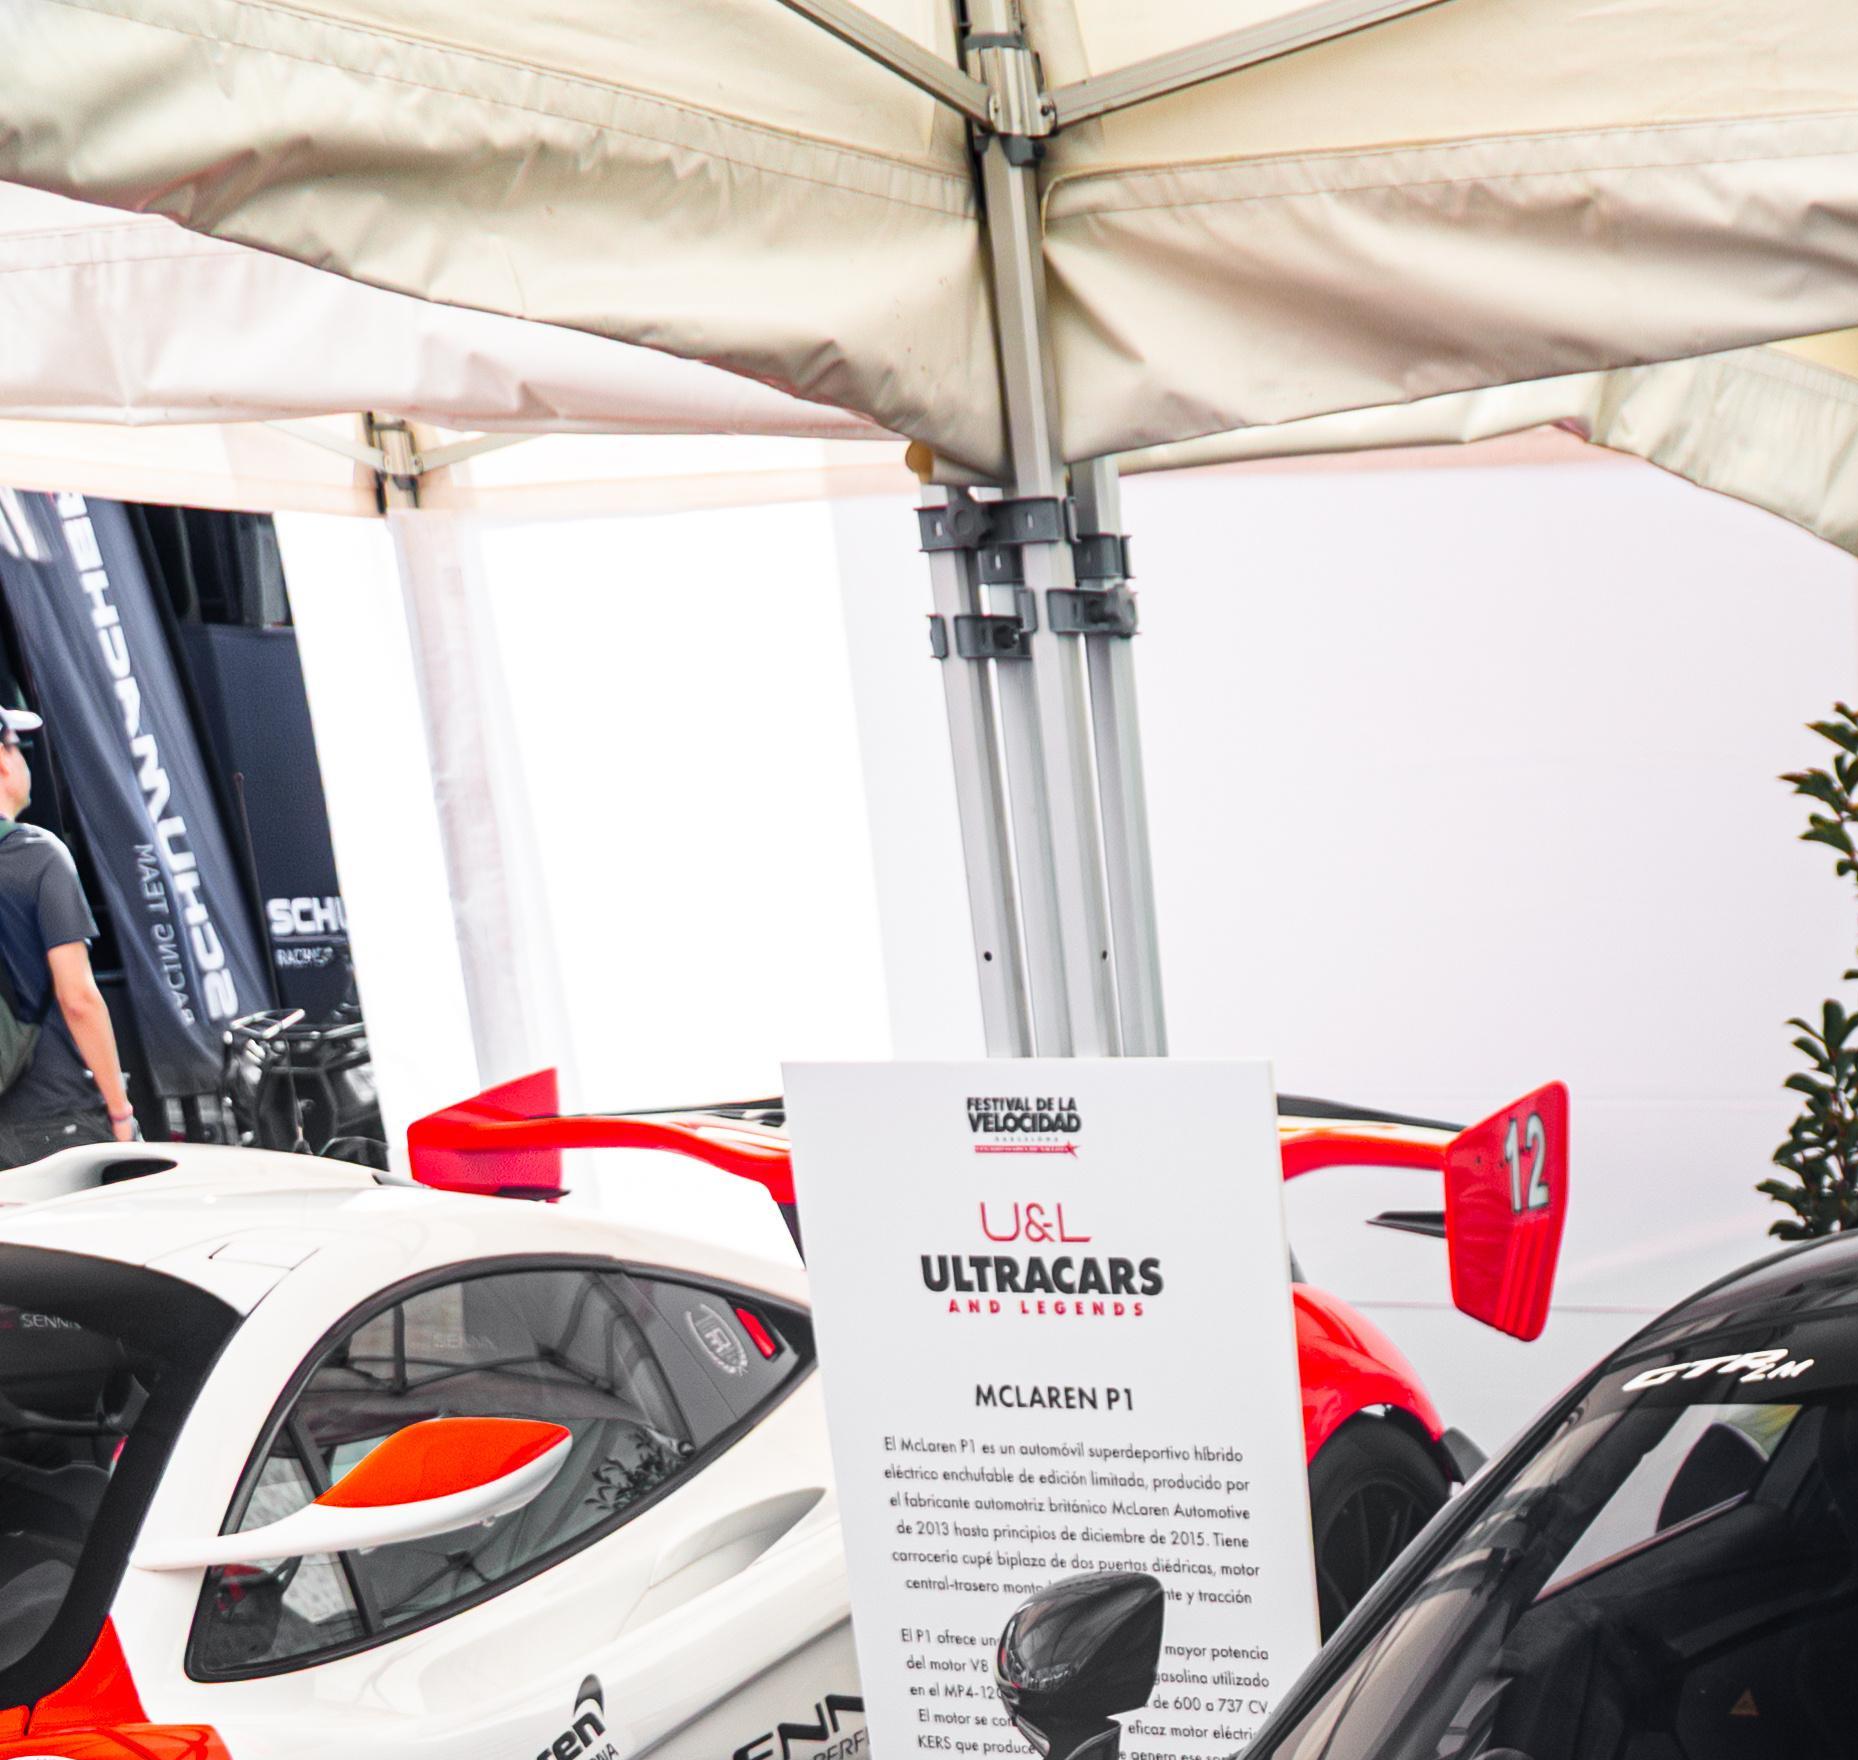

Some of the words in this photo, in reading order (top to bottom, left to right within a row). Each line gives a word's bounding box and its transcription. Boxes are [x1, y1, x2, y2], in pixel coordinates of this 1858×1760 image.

[966, 1097, 1031, 1111] FESTIVAL
[1036, 1097, 1054, 1111] DE
[1058, 1097, 1077, 1111] LA
[968, 1112, 1081, 1133] VELOCIDAD
[1504, 1112, 1550, 1214] 12
[920, 1254, 1165, 1297] ULTRACARS
[948, 1299, 1001, 1314] AND
[1020, 1300, 1145, 1317] LEGENDS
[975, 1384, 1098, 1410] MCLAREN
[1106, 1388, 1133, 1411] P1
[884, 1436, 897, 1451] El
[901, 1437, 957, 1453] McLaren
[960, 1439, 975, 1453] P1
[982, 1443, 996, 1454] es
[1000, 1444, 1016, 1455] un
[1020, 1442, 1085, 1456] automóvil
[1089, 1444, 1190, 1463] superdeportivo
[884, 1464, 939, 1480] eléctrico
[943, 1466, 1014, 1483] enchufable
[1019, 1468, 1035, 1483] de
[1039, 1469, 1087, 1485] edición
[1153, 1473, 1222, 1492] producido
[1226, 1480, 1250, 1494] por
[890, 1491, 900, 1507] el
[904, 1491, 970, 1509] fabricante
[975, 1498, 1045, 1512] automotriz
[1049, 1497, 1107, 1513] británico
[1112, 1501, 1169, 1517] McLaren
[1174, 1503, 1250, 1520] Automotive
[896, 1519, 913, 1534] de
[916, 1521, 949, 1536] 2013
[954, 1521, 989, 1537] hasta
[993, 1525, 1057, 1543] principios
[1060, 1526, 1077, 1541] de
[1081, 1527, 1145, 1544] diciembre
[1150, 1529, 1166, 1544] de
[1213, 1532, 1249, 1548] Tiene
[962, 1553, 992, 1568] cupé
[997, 1550, 1046, 1570] biplaza
[1050, 1553, 1067, 1568] de
[1071, 1553, 1094, 1569] dos
[1099, 1559, 1148, 1572] puertas
[1221, 1564, 1260, 1576] motor
[906, 1576, 1000, 1593] central-trasero
[1199, 1588, 1252, 1604] tracción
[901, 1628, 913, 1643] El
[916, 1629, 931, 1643] P1
[937, 1631, 977, 1645] ofrece
[1165, 1645, 1207, 1660] mayor
[1211, 1646, 1269, 1661] potencia
[906, 1655, 926, 1669] del
[930, 1659, 967, 1672] motor
[1212, 1671, 1270, 1688] utilizado
[910, 1685, 926, 1696] en
[929, 1682, 940, 1697] el
[1153, 1694, 1169, 1709] de
[1174, 1696, 1201, 1711] 600
[1218, 1698, 1243, 1713] 737
[918, 1708, 930, 1722] El
[934, 1711, 971, 1724] motor
[975, 1715, 988, 1726] se
[1128, 1720, 1167, 1736] eficaz
[1170, 1725, 1208, 1738] motor
[917, 1734, 952, 1749] KERS
[955, 1742, 979, 1755] que
